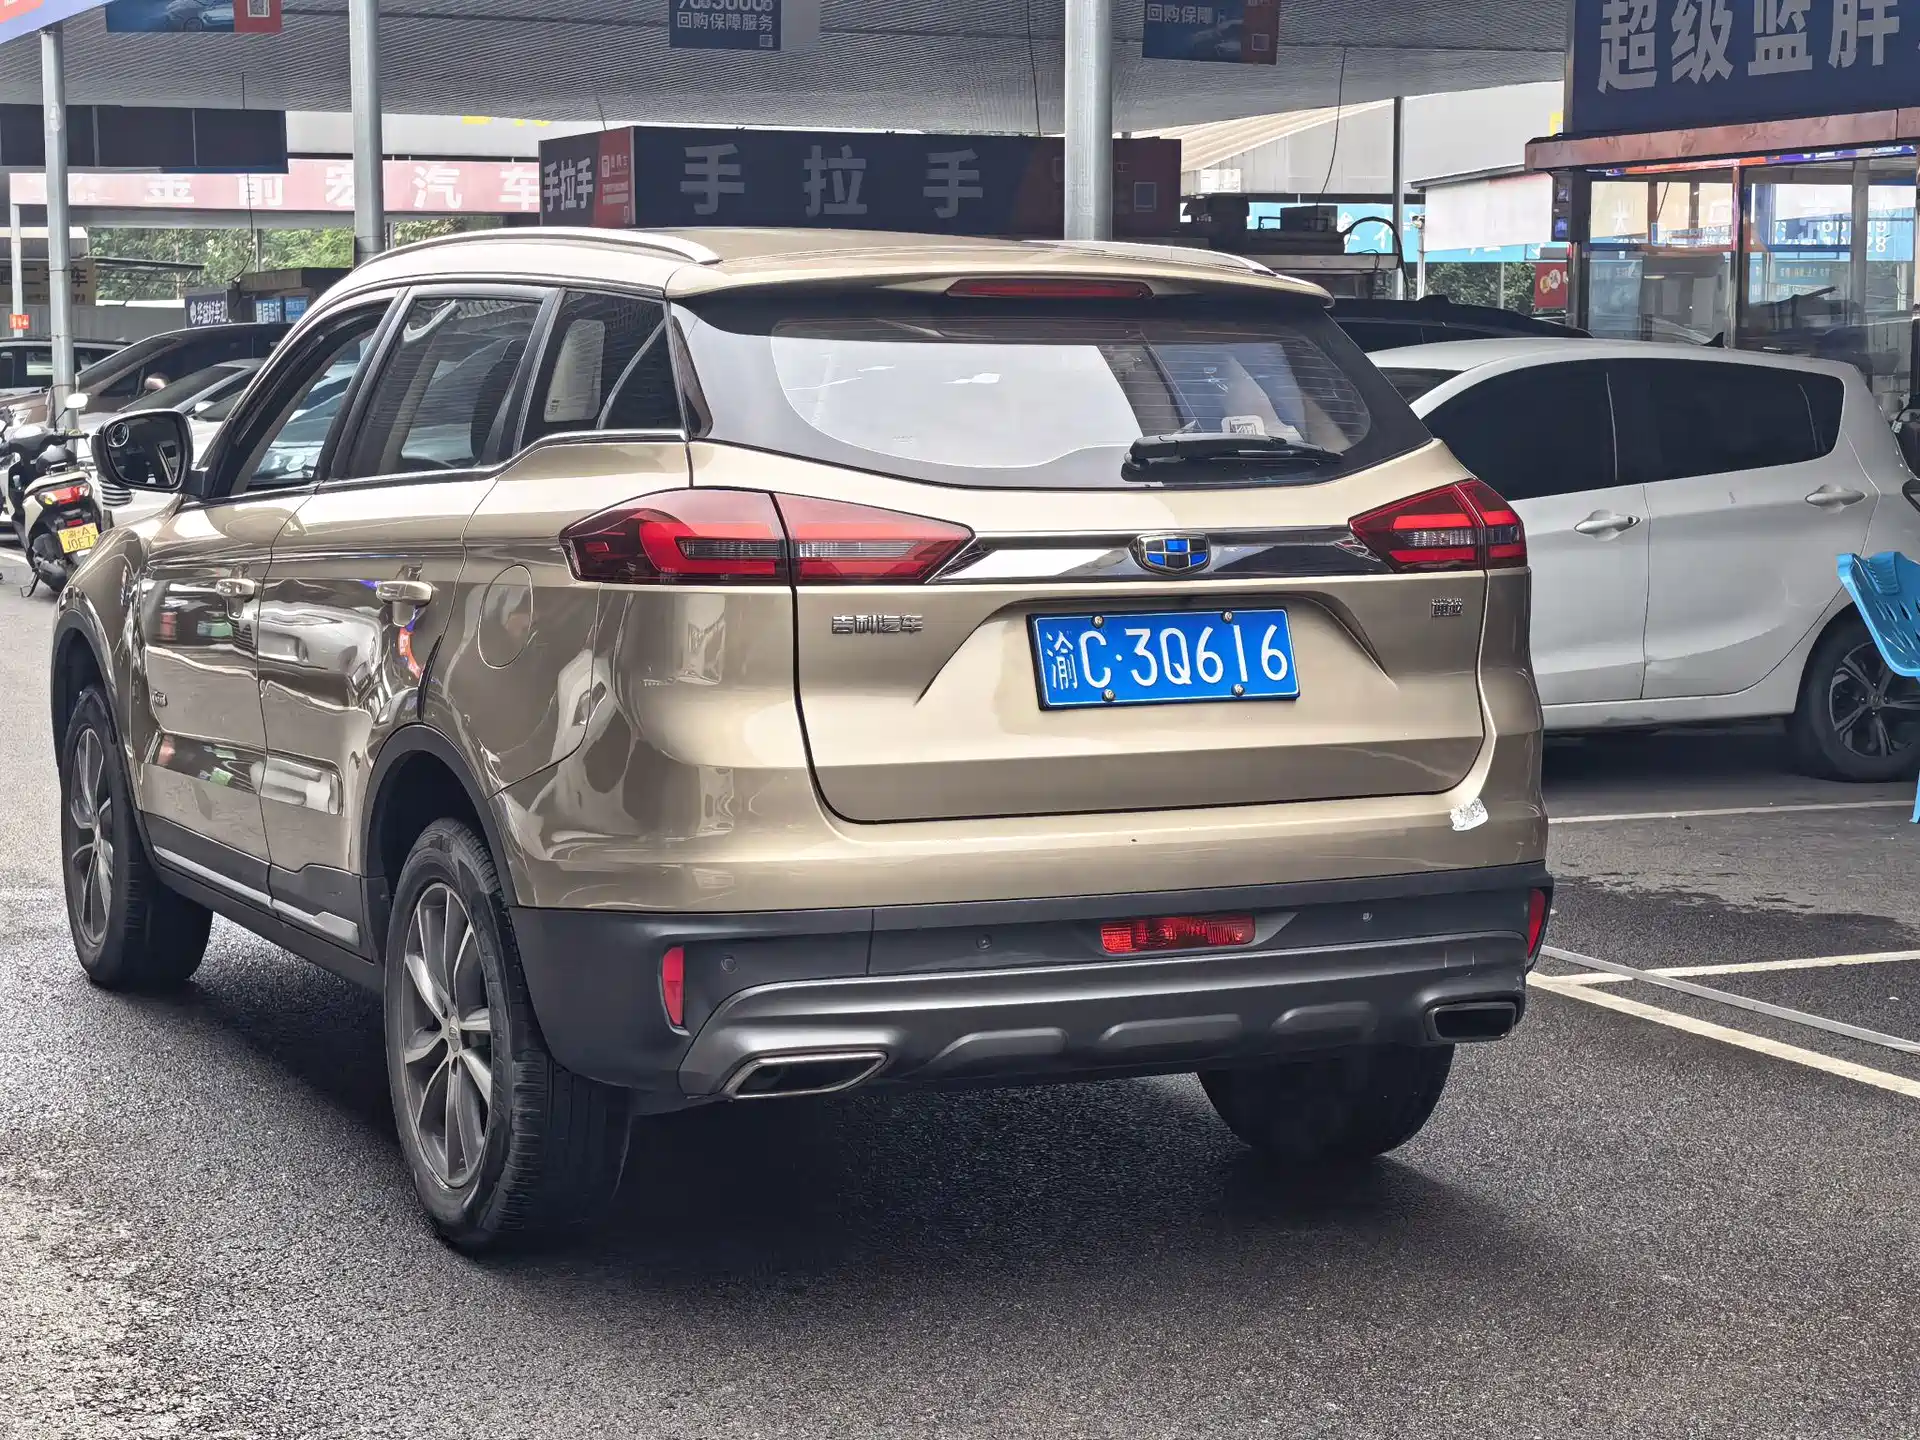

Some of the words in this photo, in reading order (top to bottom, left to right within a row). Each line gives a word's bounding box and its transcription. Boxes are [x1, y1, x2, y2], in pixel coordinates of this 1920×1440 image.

[677, 11, 774, 31] 回购保障服务
[543, 157, 593, 212] 手拉手
[680, 145, 984, 219] 手拉手
[831, 614, 924, 634] 吉利汽车
[1045, 625, 1289, 690] 渝C·3Q616
